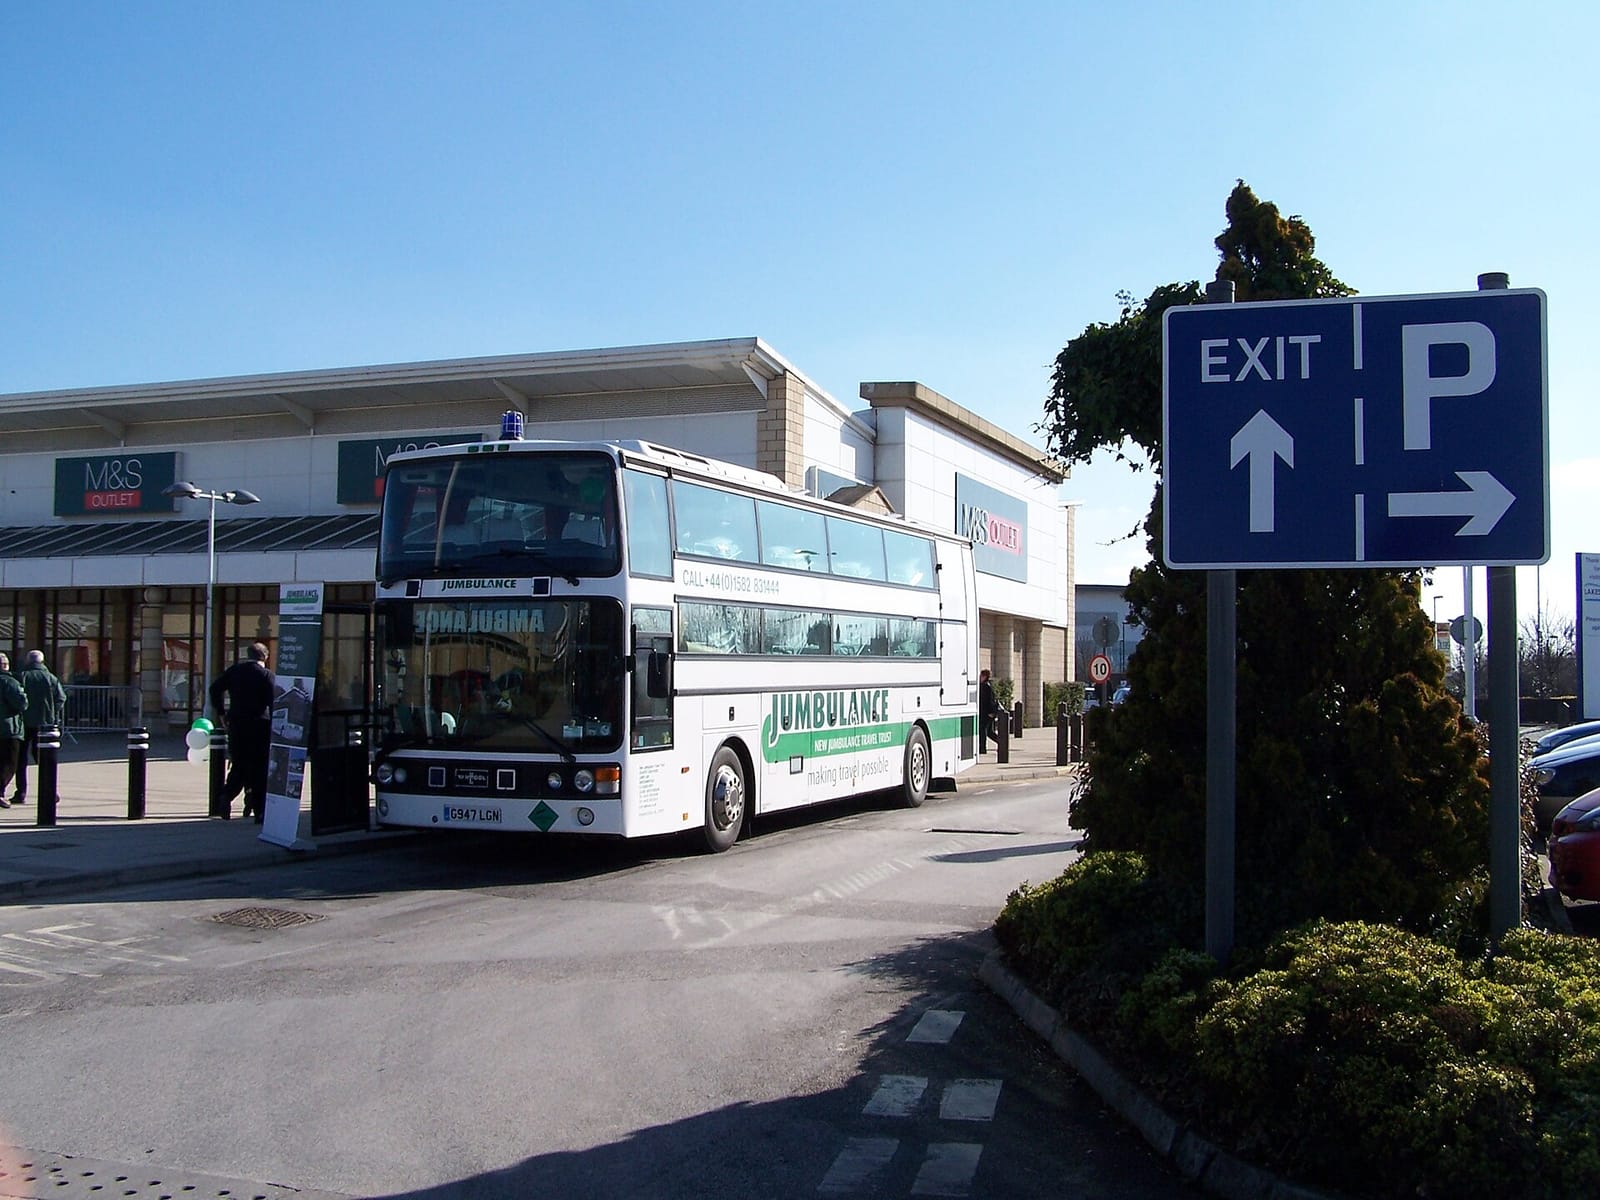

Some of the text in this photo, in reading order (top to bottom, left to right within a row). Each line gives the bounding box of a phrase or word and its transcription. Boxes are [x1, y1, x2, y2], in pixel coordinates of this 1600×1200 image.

[1201, 335, 1321, 383] EXIT
[1402, 321, 1496, 450] P
[86, 459, 142, 490] M&S
[92, 493, 134, 507] OUTLET
[442, 579, 517, 592] JUMBULANCE
[683, 569, 704, 588] CALL
[1093, 663, 1107, 675] 10
[770, 690, 888, 745] JUMBULANCE
[814, 738, 828, 753] NEW
[862, 733, 878, 746] TRAVEL
[879, 731, 892, 743] TRUST
[808, 755, 889, 787] making travel possible
[450, 808, 499, 821] G947 LGN
